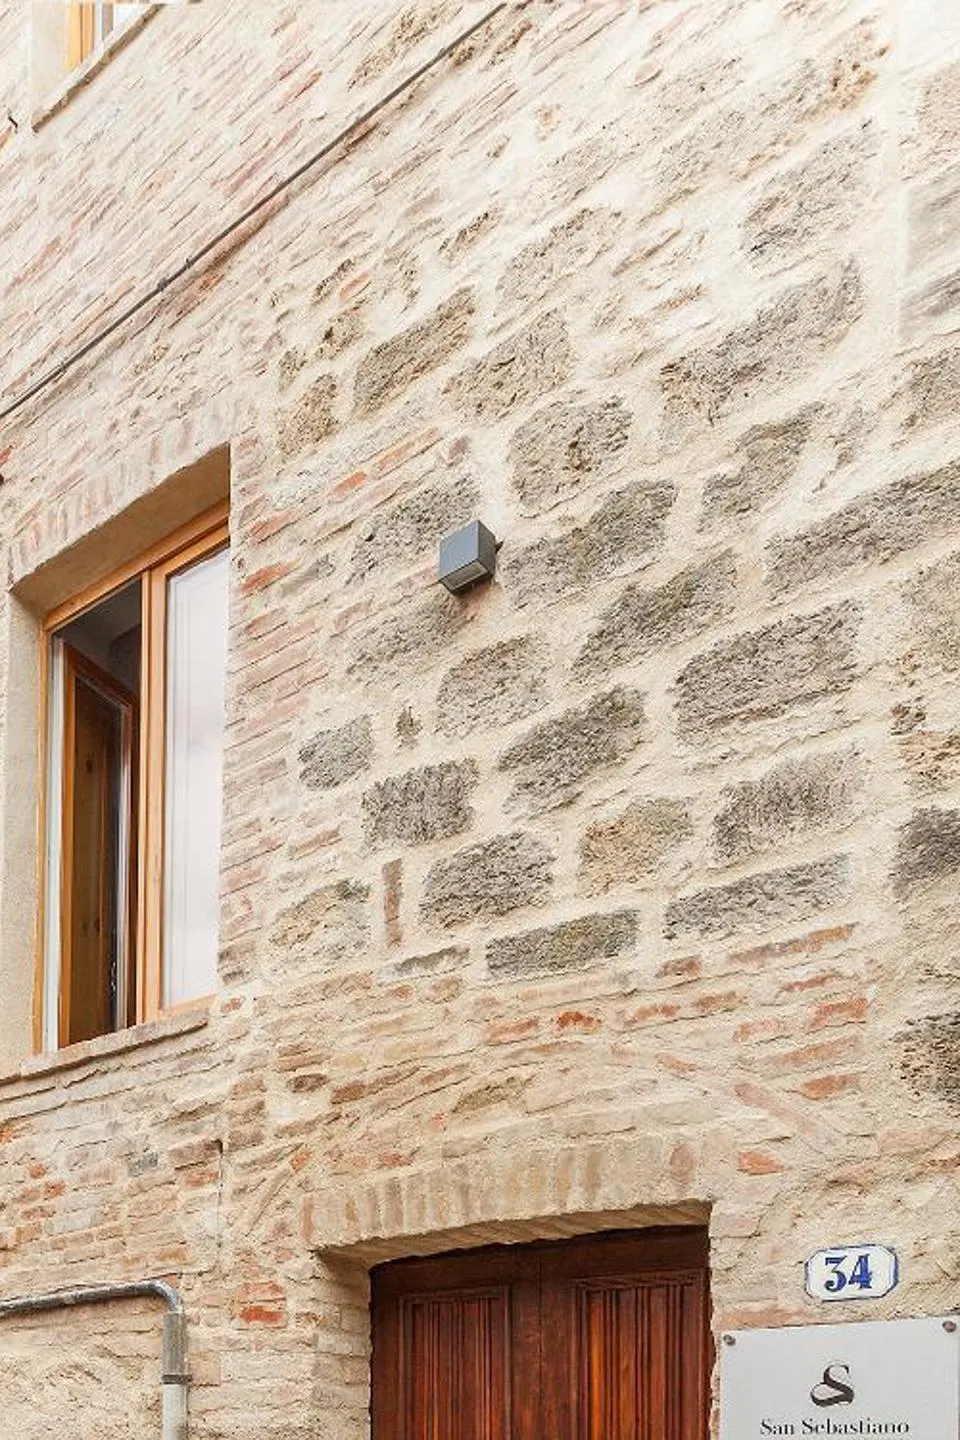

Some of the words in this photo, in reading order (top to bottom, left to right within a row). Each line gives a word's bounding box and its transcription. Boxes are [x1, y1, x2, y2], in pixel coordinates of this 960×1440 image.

[823, 1253, 873, 1293] 34
[759, 1418, 795, 1436] San
[801, 1416, 910, 1436] Sebastiano
